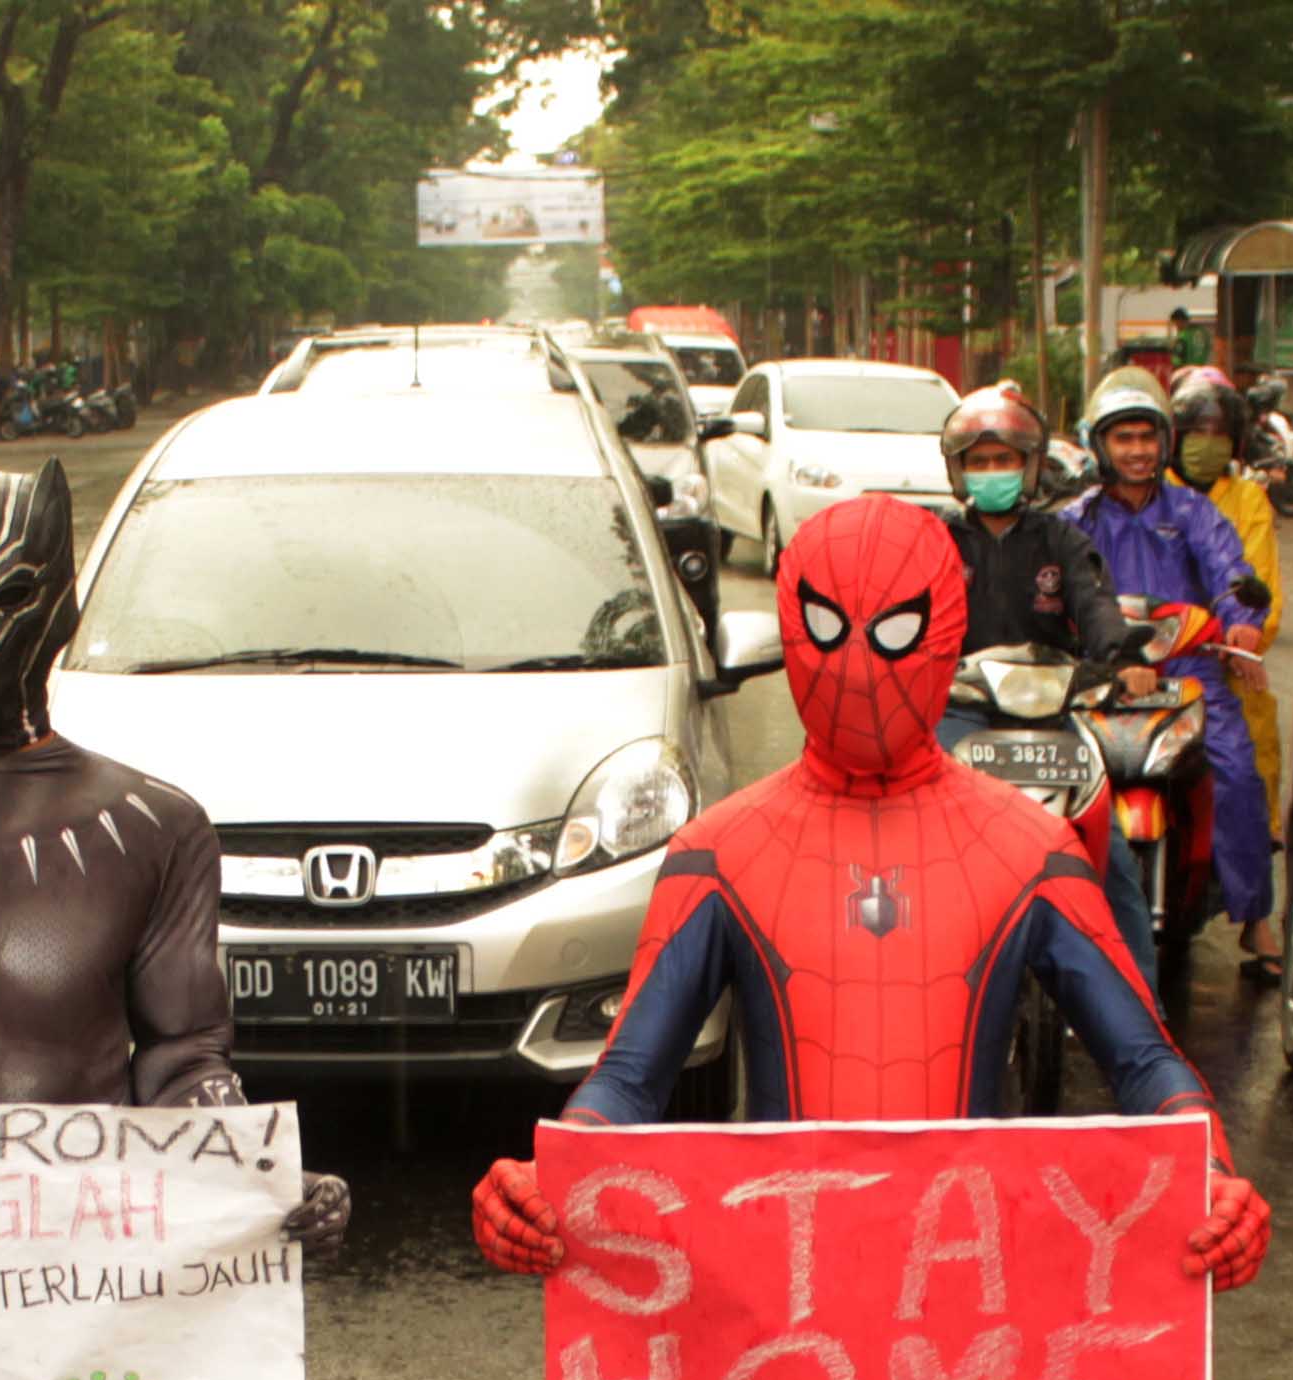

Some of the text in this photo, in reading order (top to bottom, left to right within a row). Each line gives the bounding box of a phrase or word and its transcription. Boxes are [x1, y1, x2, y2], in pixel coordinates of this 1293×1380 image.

[232, 957, 448, 998] DD 1089 KW
[562, 1154, 1176, 1323] STAY
[177, 1246, 292, 1297] JAUH
